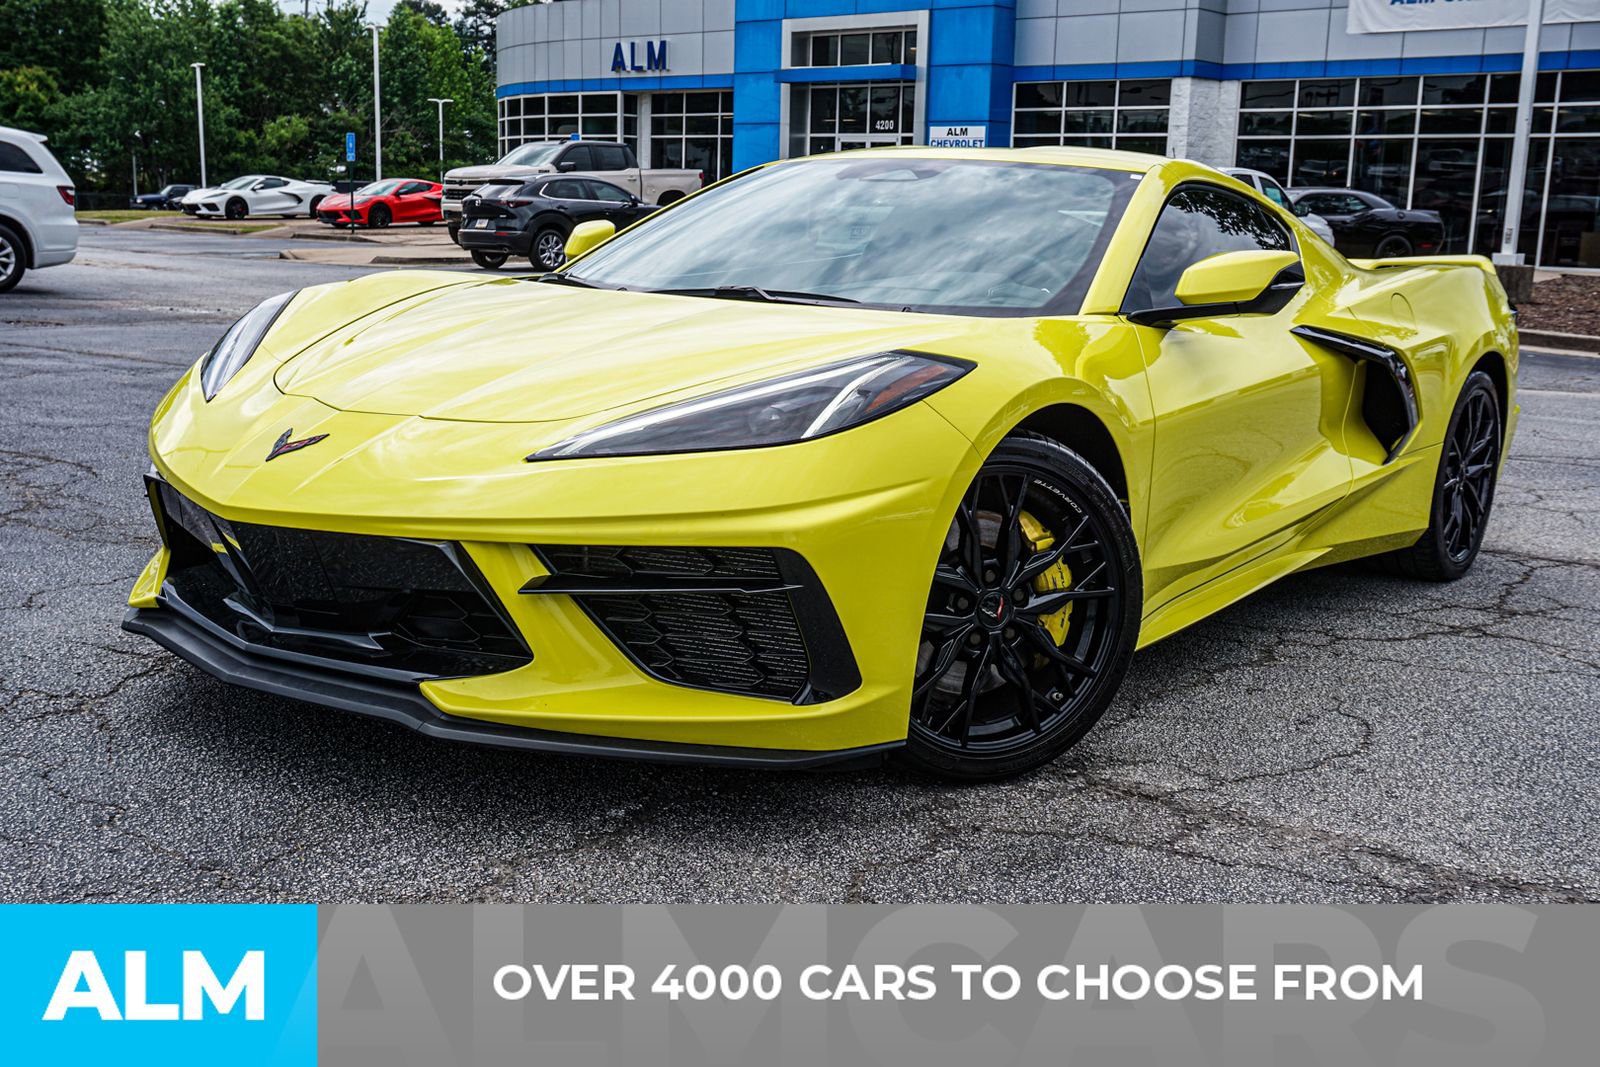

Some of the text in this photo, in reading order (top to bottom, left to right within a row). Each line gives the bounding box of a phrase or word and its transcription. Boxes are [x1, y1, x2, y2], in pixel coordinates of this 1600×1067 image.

[611, 40, 668, 72] ALM
[875, 120, 894, 130] 4200
[946, 127, 968, 136] ALM
[930, 139, 984, 148] CHEVROLET
[1033, 479, 1082, 513] CORVETTE
